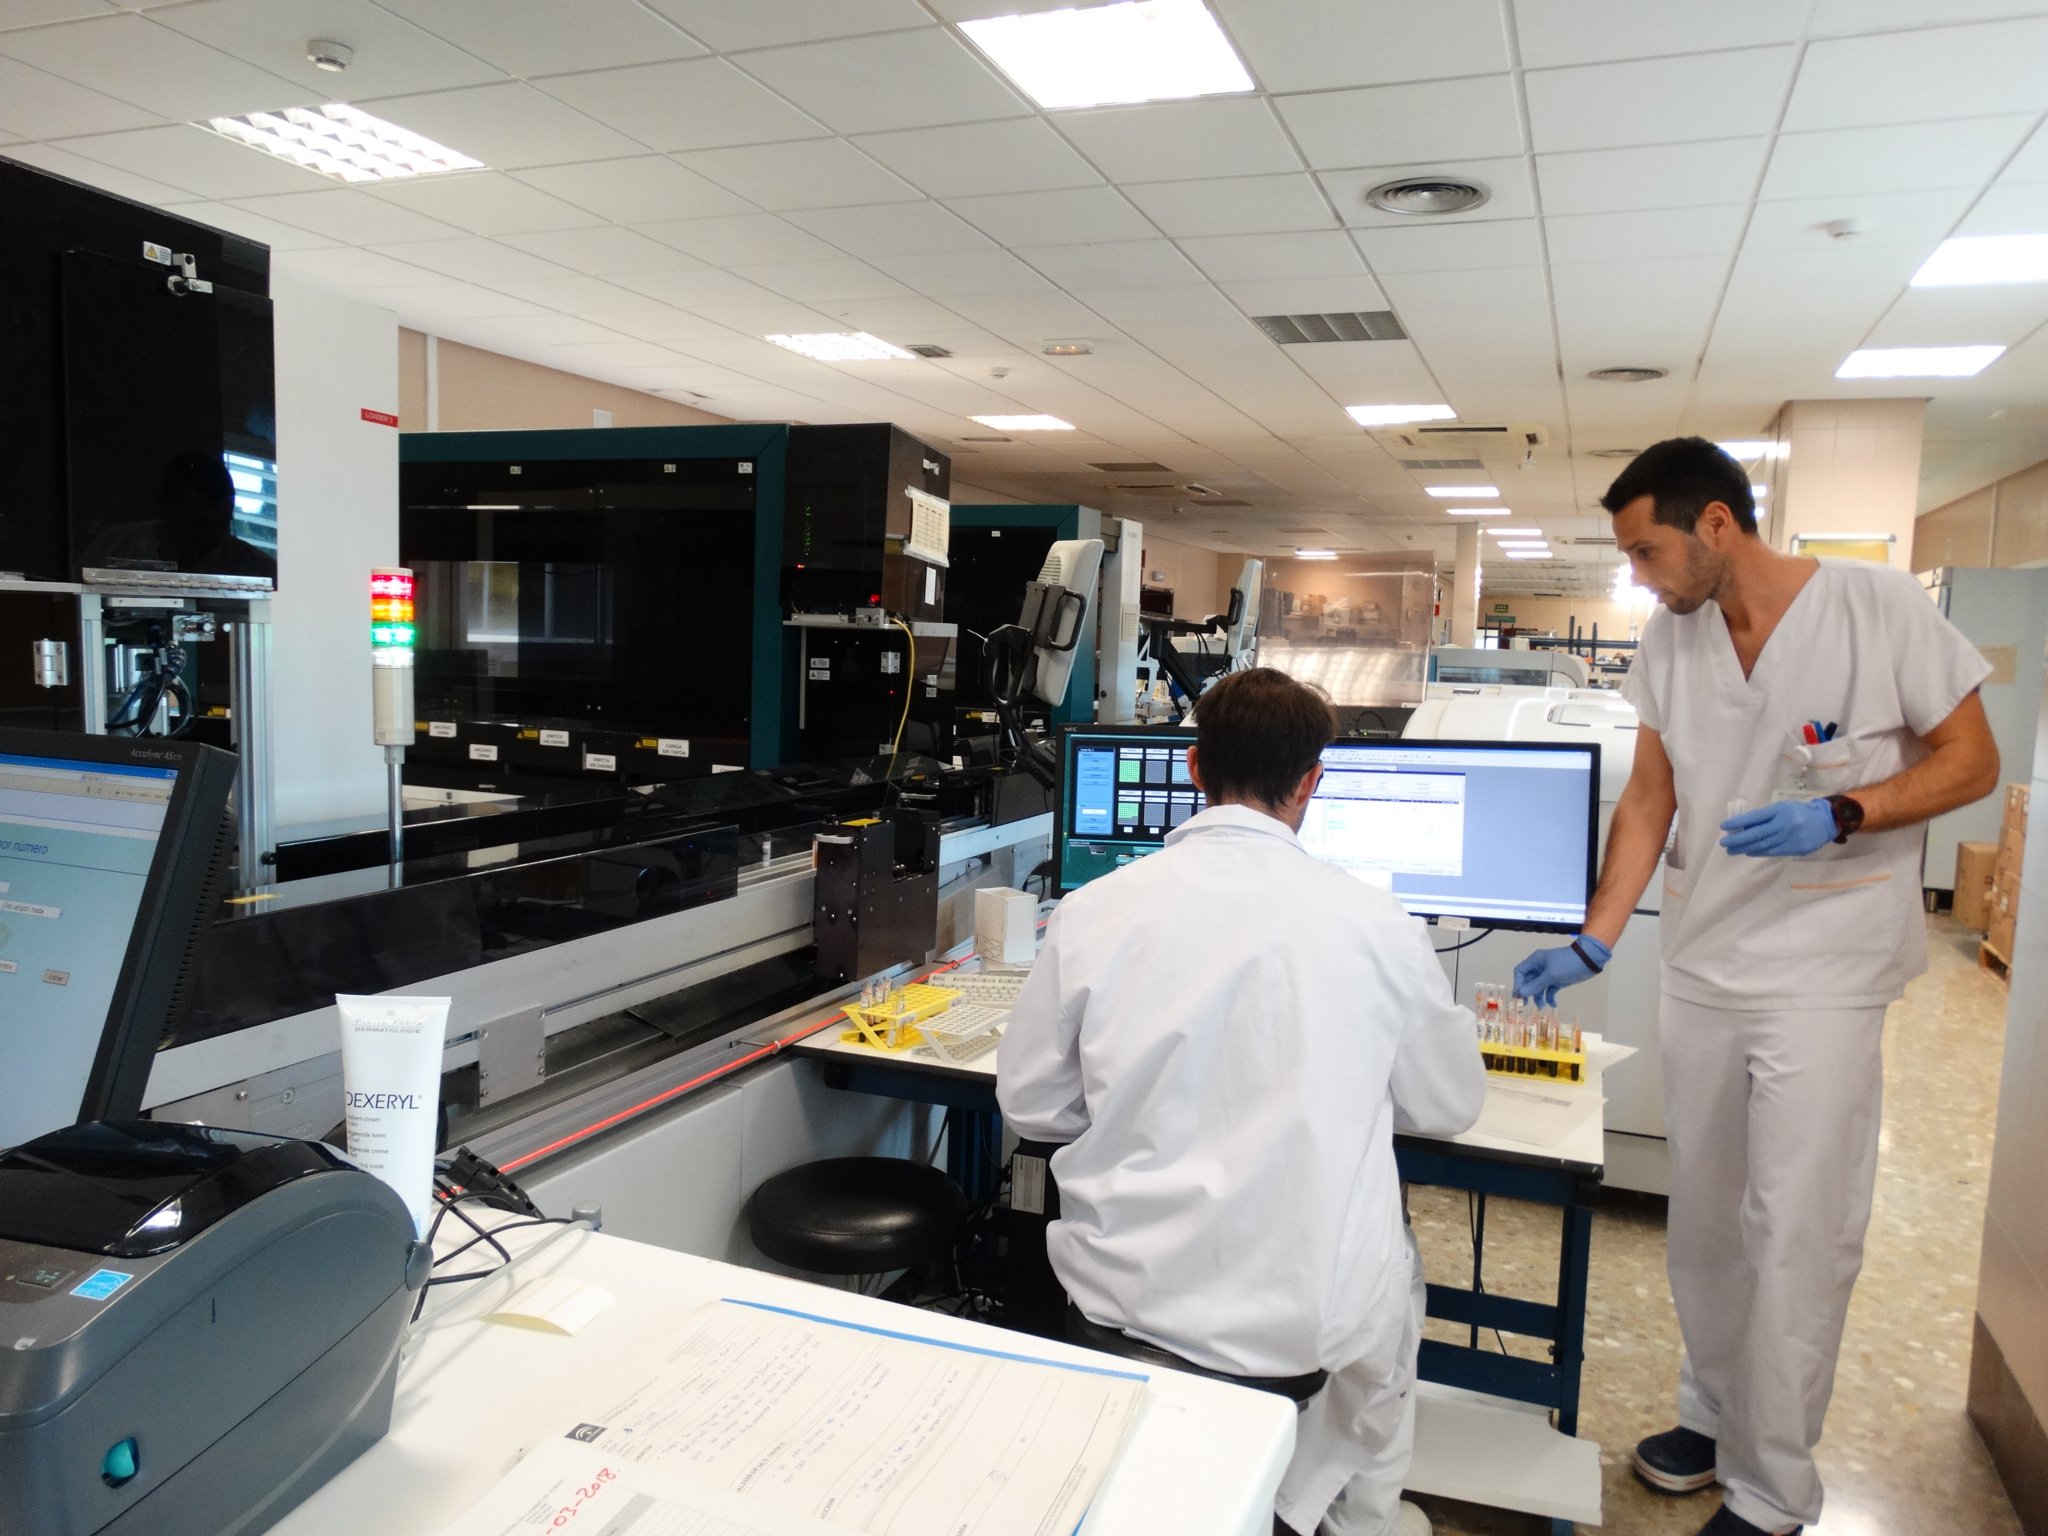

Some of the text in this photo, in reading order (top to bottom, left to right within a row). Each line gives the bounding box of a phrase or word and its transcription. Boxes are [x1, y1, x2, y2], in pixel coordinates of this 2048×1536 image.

[365, 411, 389, 422] LOADER
[14, 841, 48, 855] número
[354, 1026, 422, 1034] DERMATOLOGIE
[538, 1467, 617, 1536] -03-2018
